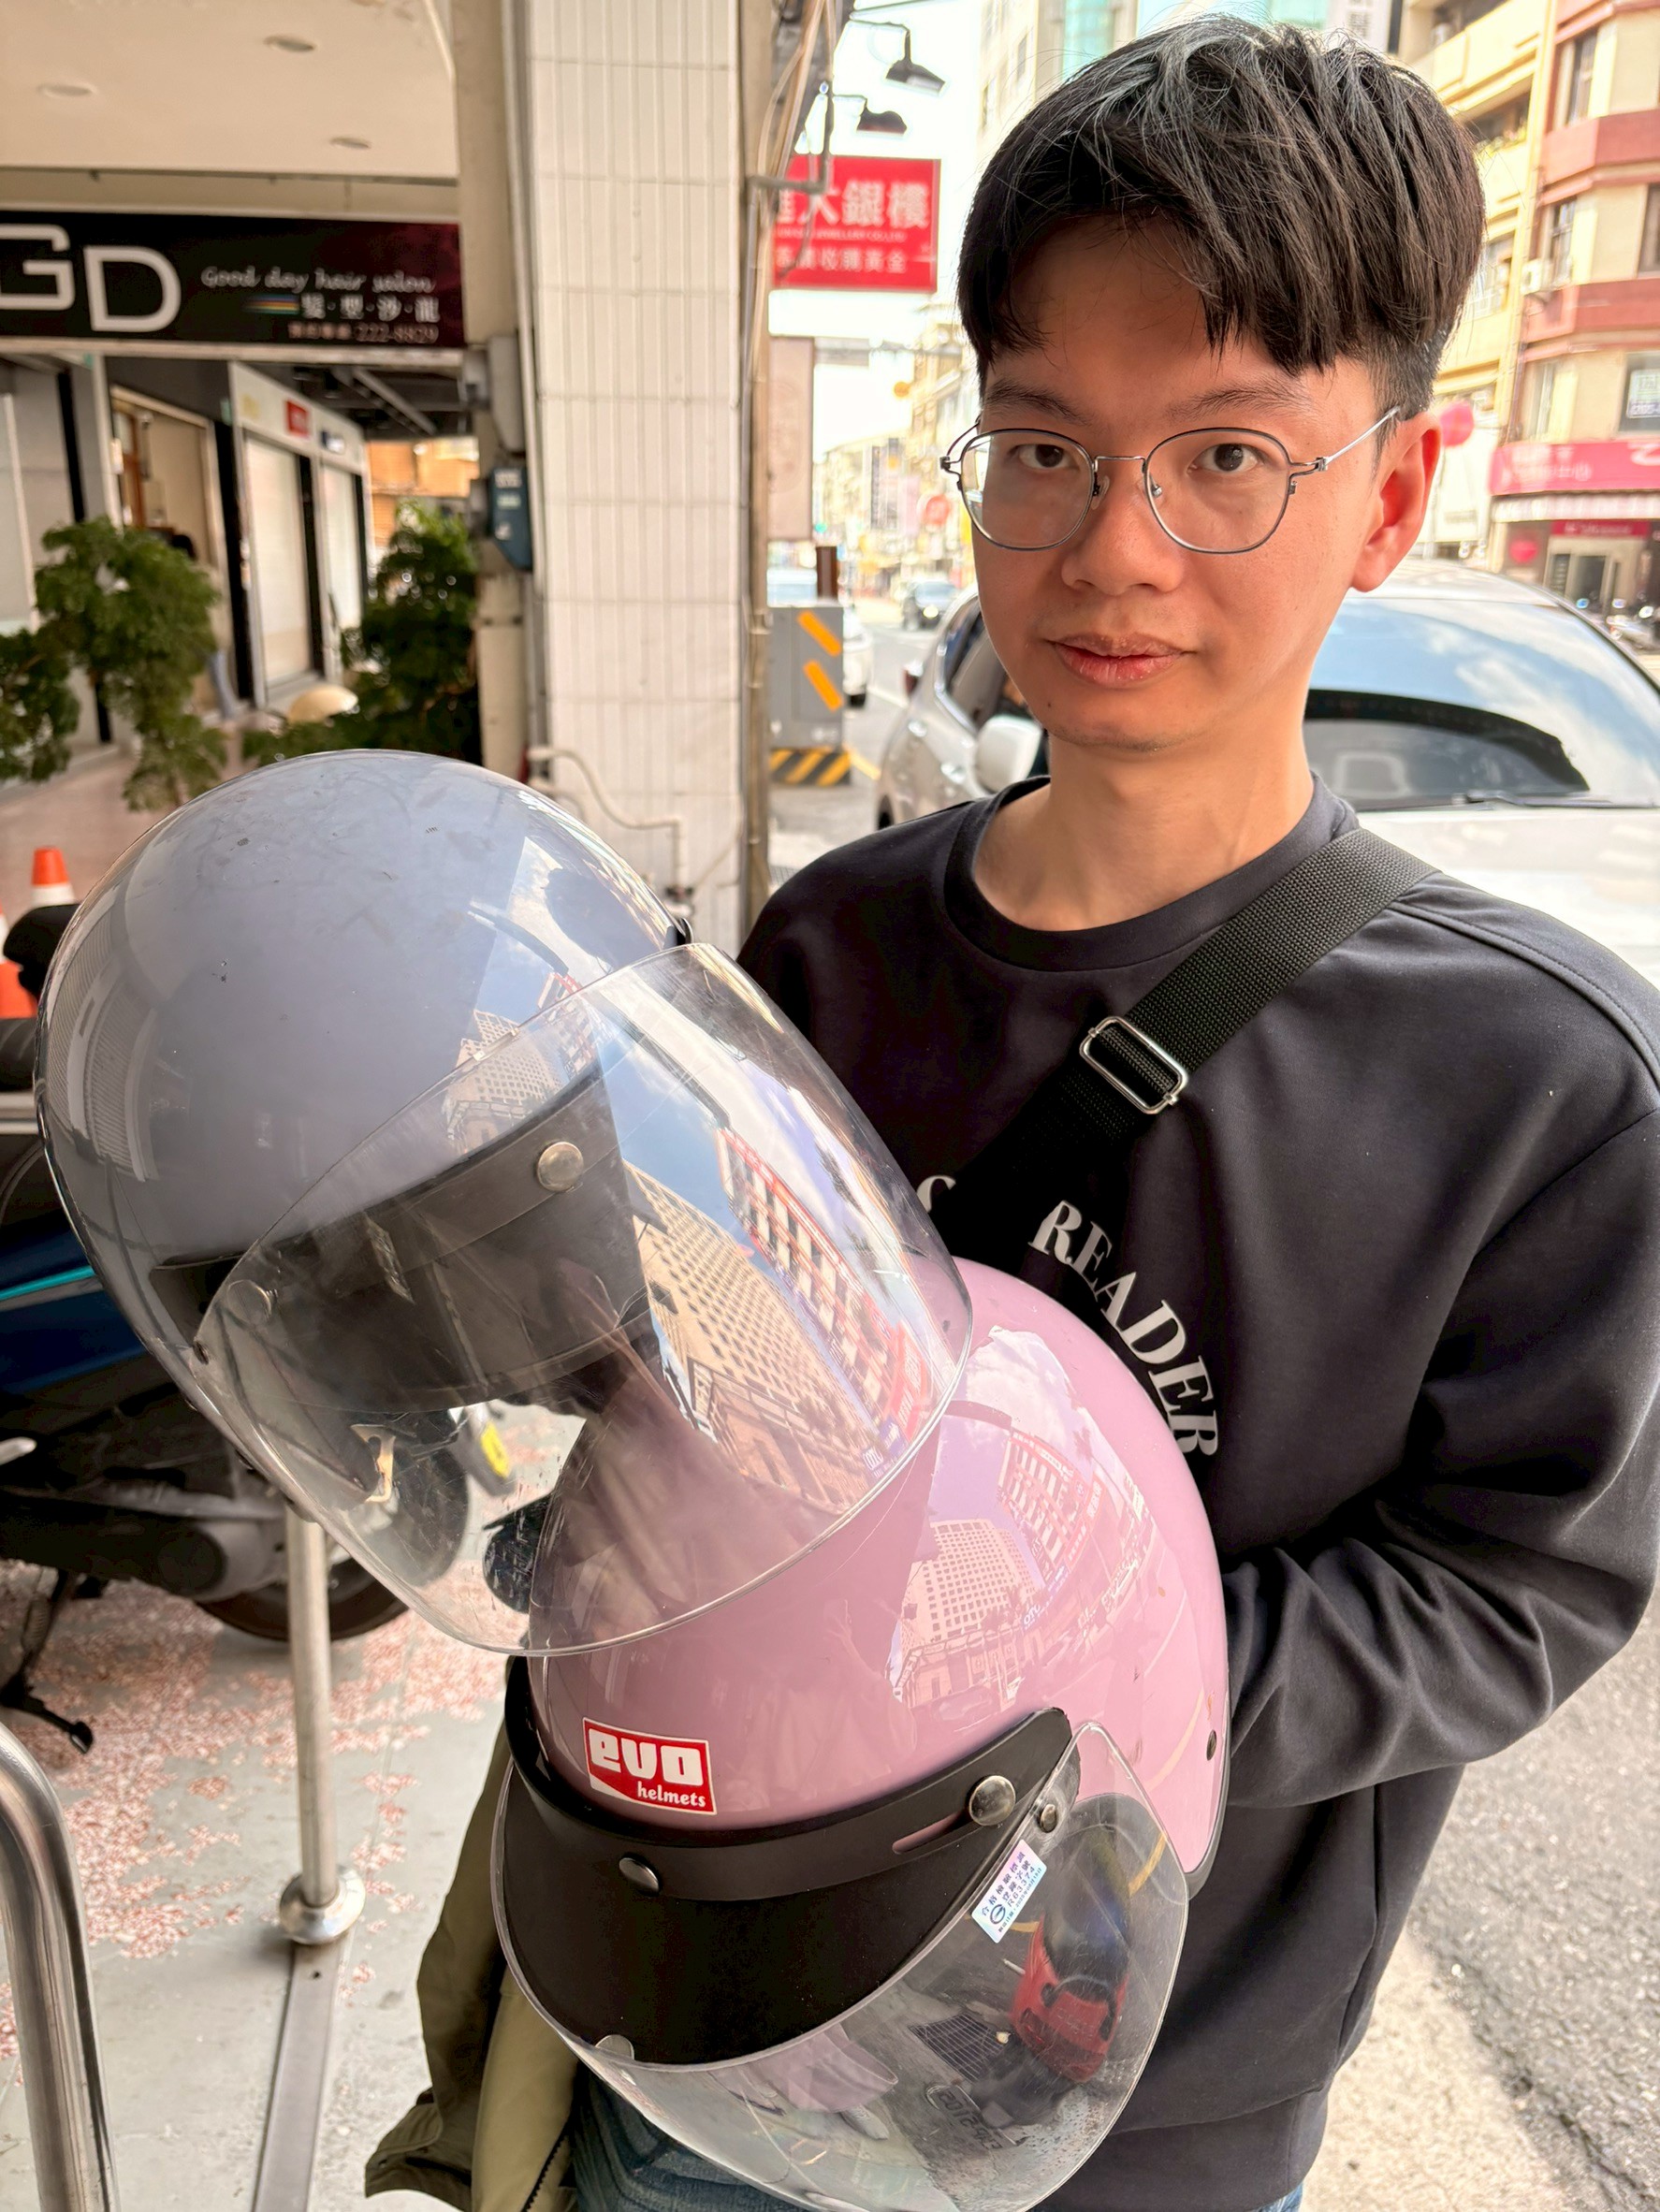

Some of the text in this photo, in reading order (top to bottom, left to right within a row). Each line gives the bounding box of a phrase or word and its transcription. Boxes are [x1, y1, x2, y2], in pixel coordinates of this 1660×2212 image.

[0, 223, 182, 333] GD
[200, 265, 260, 288] Good
[264, 266, 309, 294] day
[314, 268, 367, 291] hair
[1027, 1200, 1218, 1456] READER
[589, 1727, 705, 1786] evo
[637, 1781, 706, 1807] helmets
[1007, 1866, 1035, 1908] R63374
